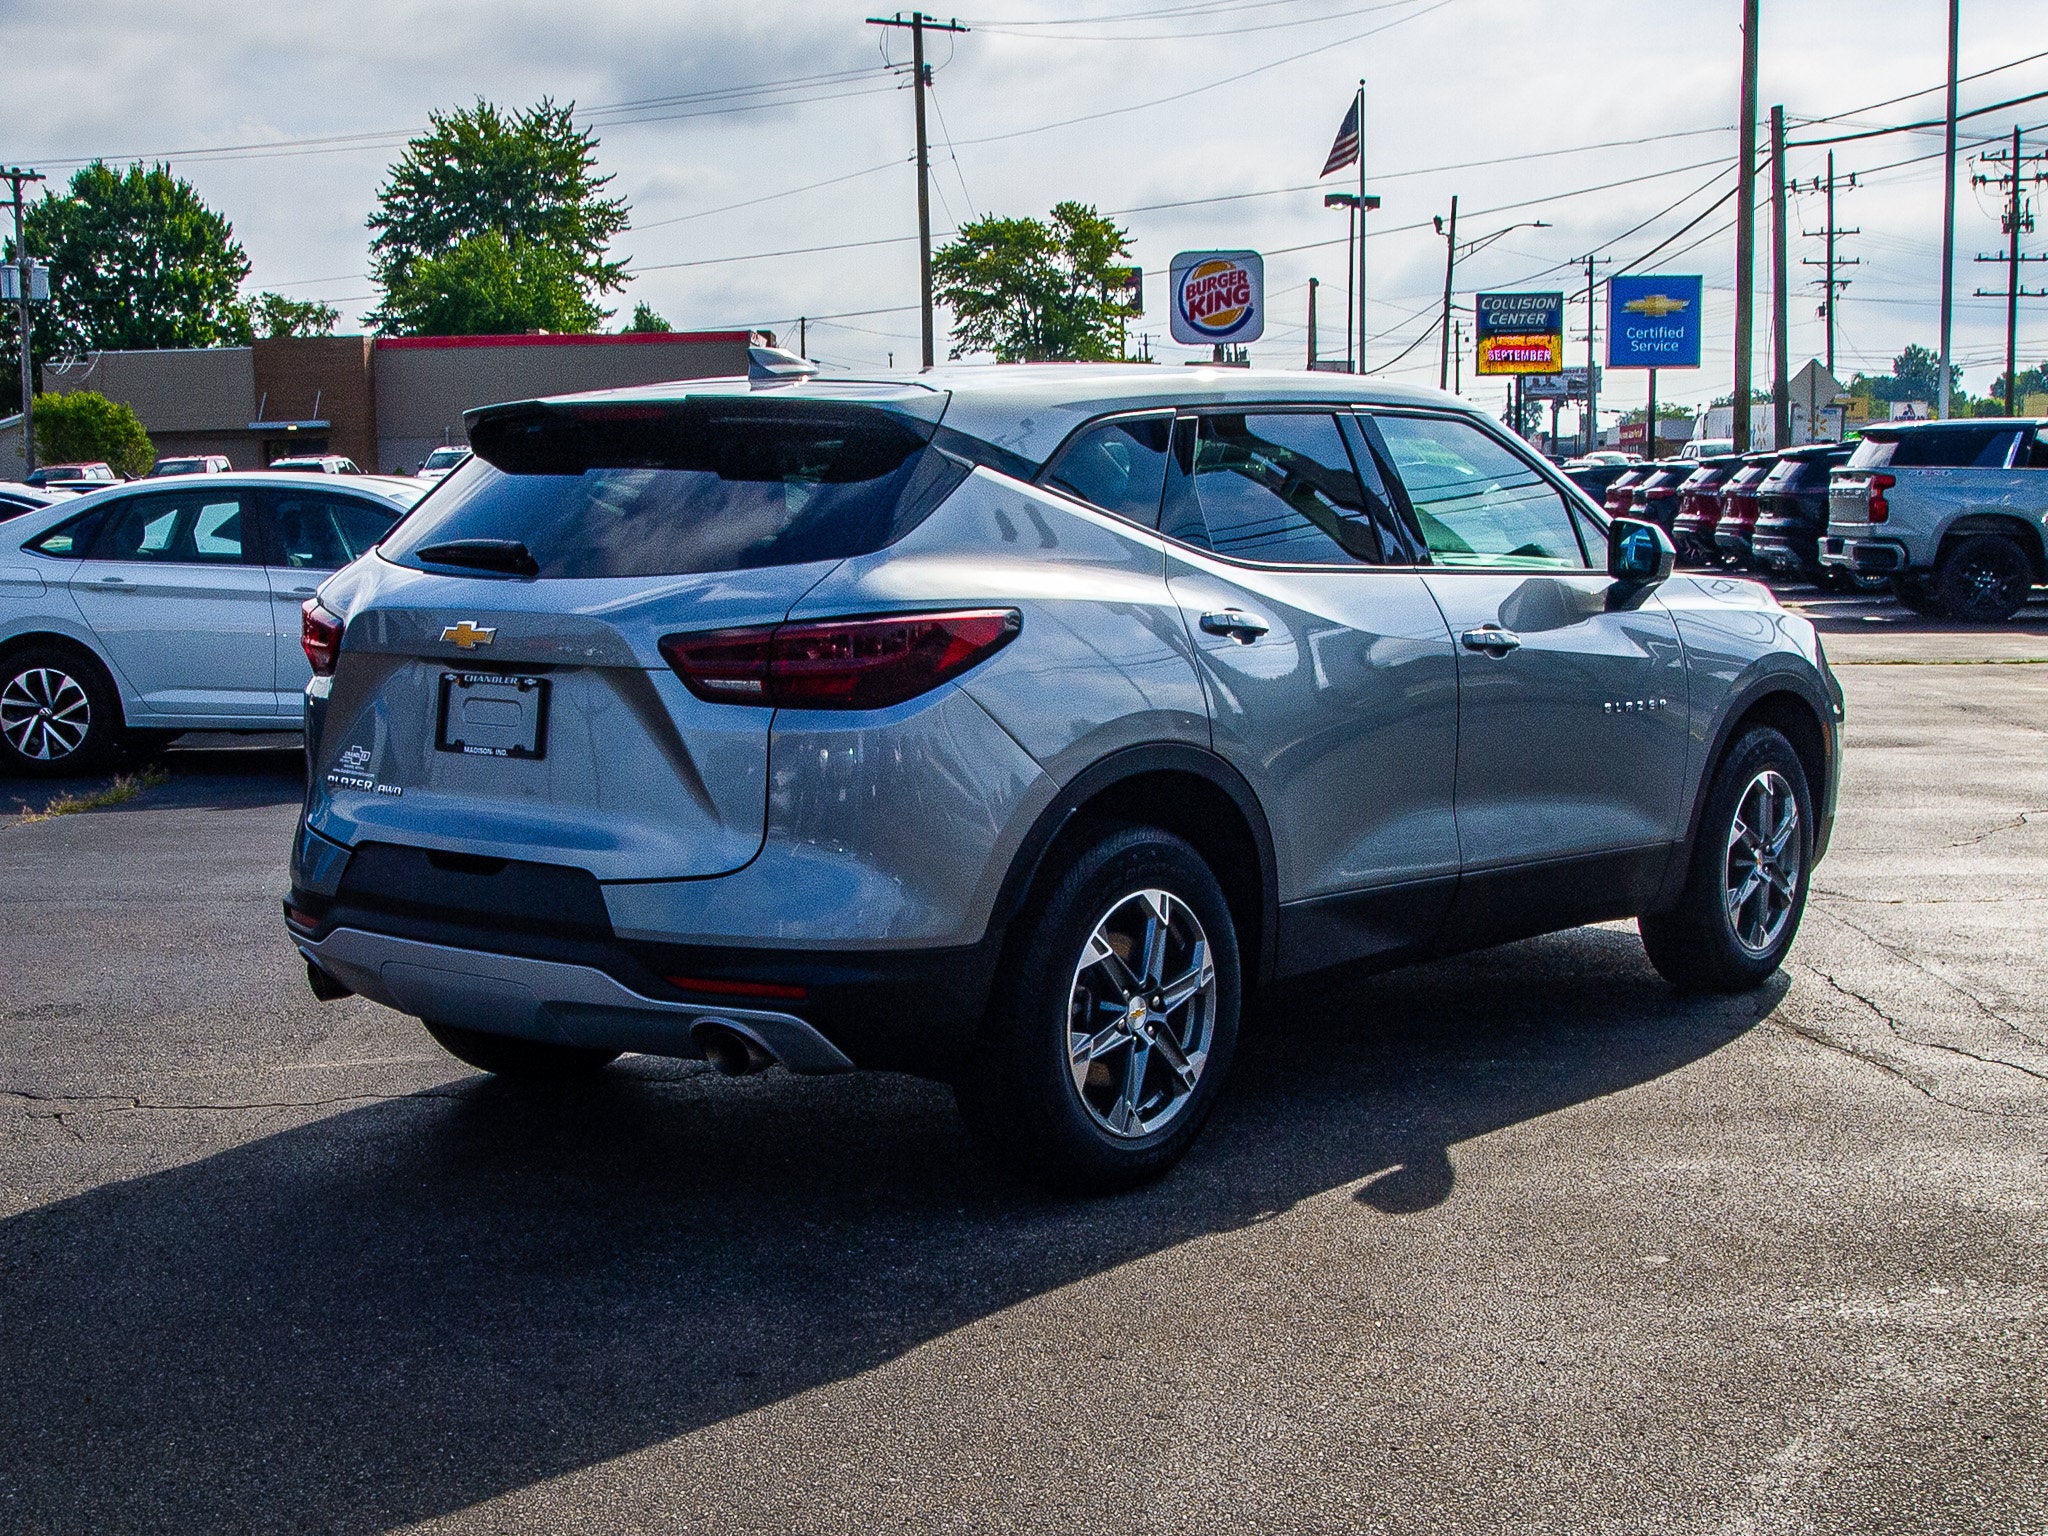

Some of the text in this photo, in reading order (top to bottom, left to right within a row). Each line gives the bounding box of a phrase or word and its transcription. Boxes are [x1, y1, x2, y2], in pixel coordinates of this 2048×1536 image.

[1186, 269, 1248, 301] BURGER
[1188, 283, 1250, 321] KING
[1481, 297, 1557, 310] COLLISION
[1489, 312, 1546, 325] CENTER
[1626, 326, 1684, 339] Certified
[1631, 340, 1679, 352] Service
[1488, 349, 1551, 361] SEPTEMBER
[464, 674, 518, 685] CHANDLER
